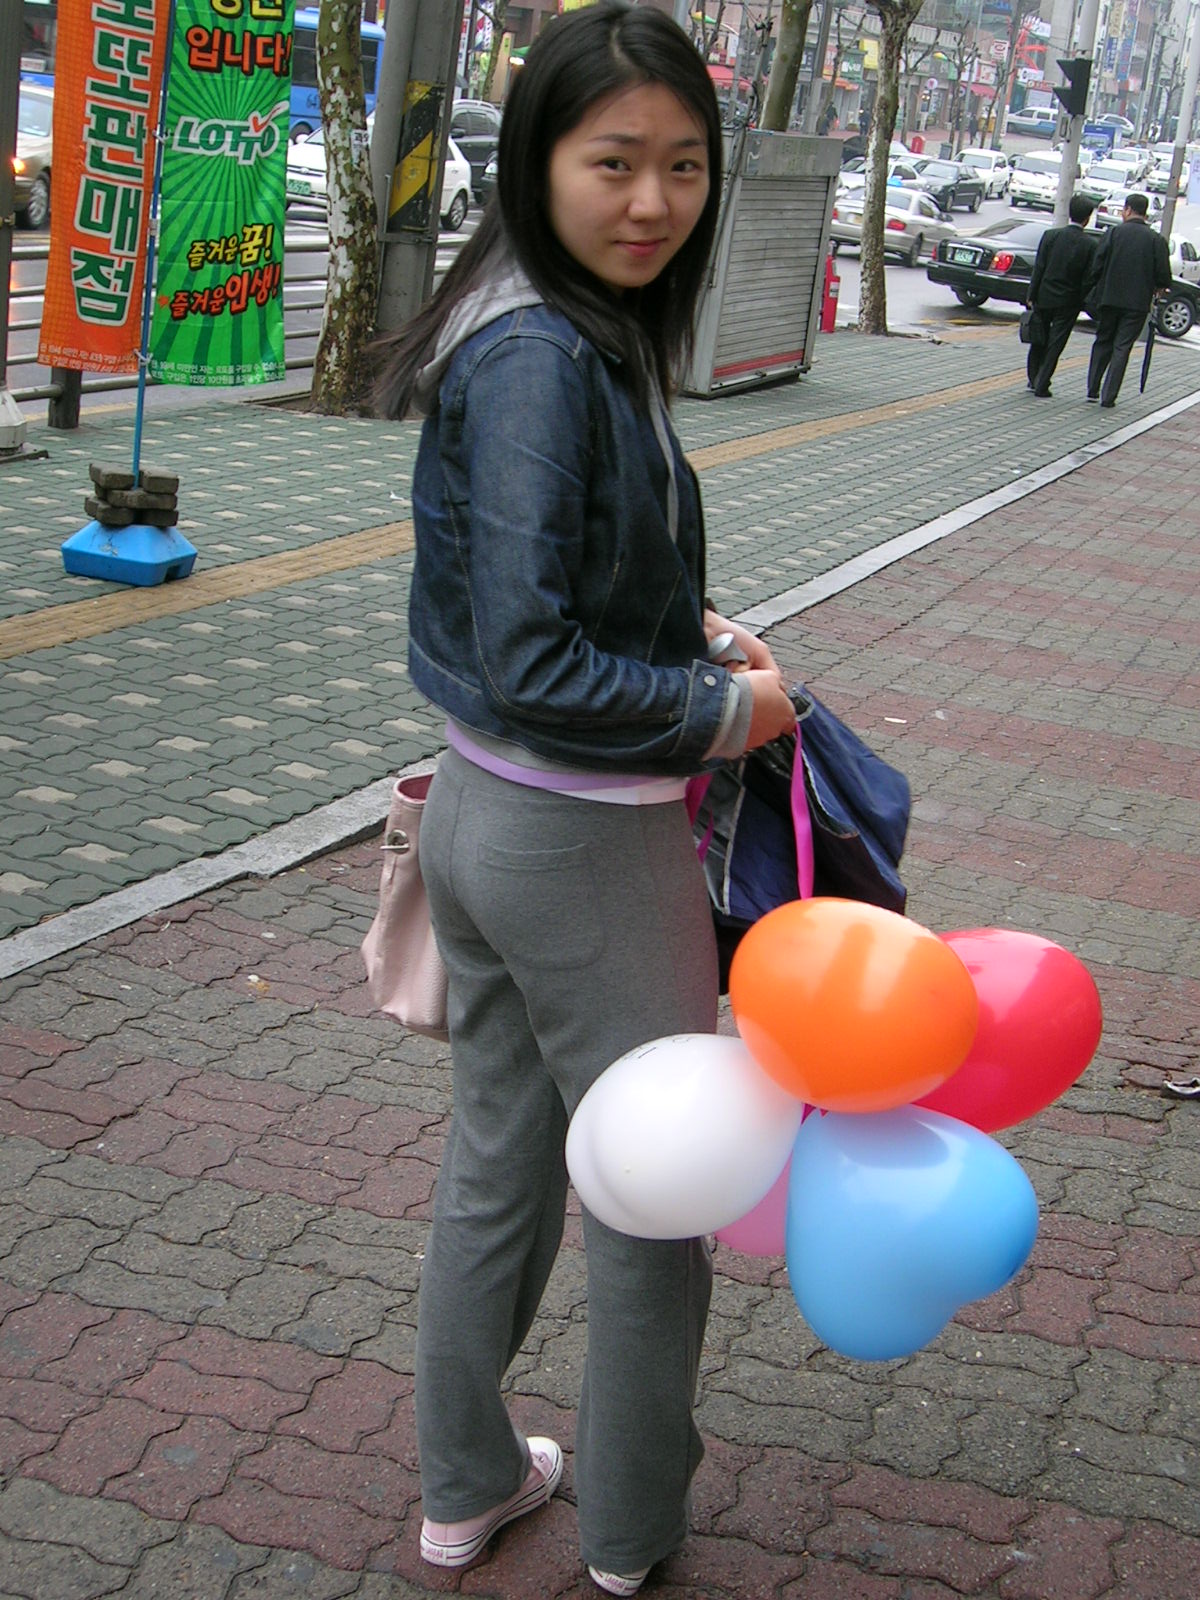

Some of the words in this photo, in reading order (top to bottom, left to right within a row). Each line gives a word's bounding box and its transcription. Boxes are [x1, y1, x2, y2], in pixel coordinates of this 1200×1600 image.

[186, 25, 292, 76] 입니다!
[172, 115, 280, 165] LOTTO
[224, 261, 282, 315] 인생!
